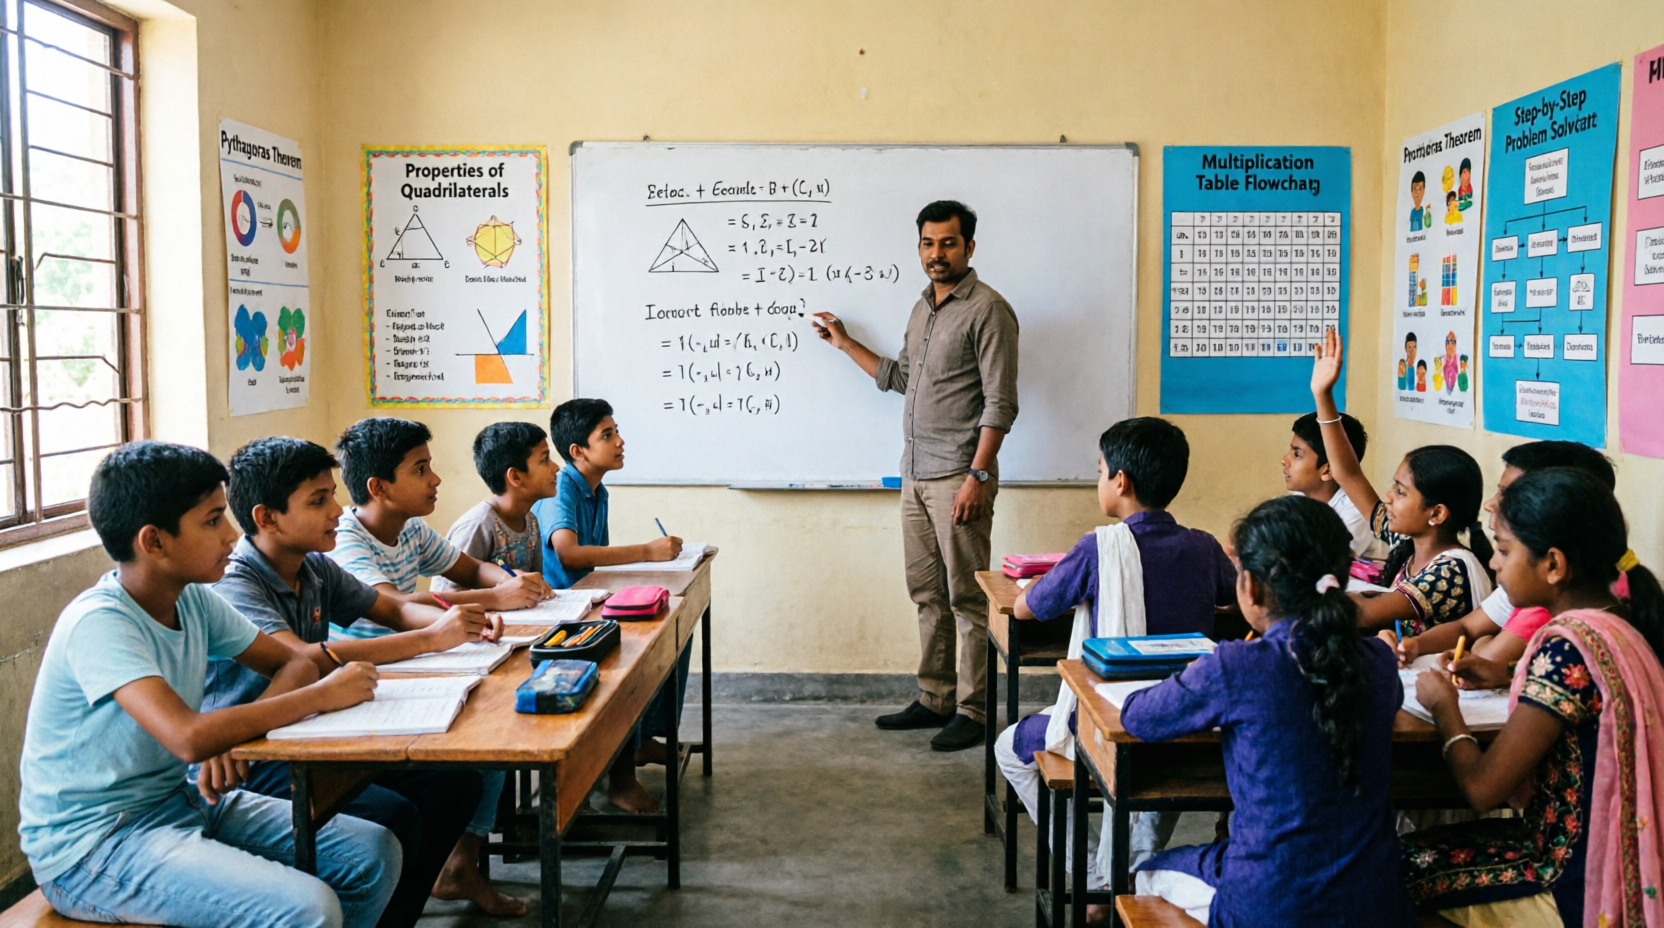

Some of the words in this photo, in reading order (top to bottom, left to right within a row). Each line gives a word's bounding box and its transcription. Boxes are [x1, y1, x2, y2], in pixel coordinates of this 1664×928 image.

[1514, 90, 1587, 126] Step-by-Step
[221, 130, 271, 160] Pythagoras
[1505, 127, 1547, 154] Problem
[405, 163, 484, 181] Properties
[488, 162, 505, 178] of
[1202, 153, 1314, 174] Multiplication
[400, 182, 509, 200] Quadrilaterals
[1196, 173, 1240, 191] Table
